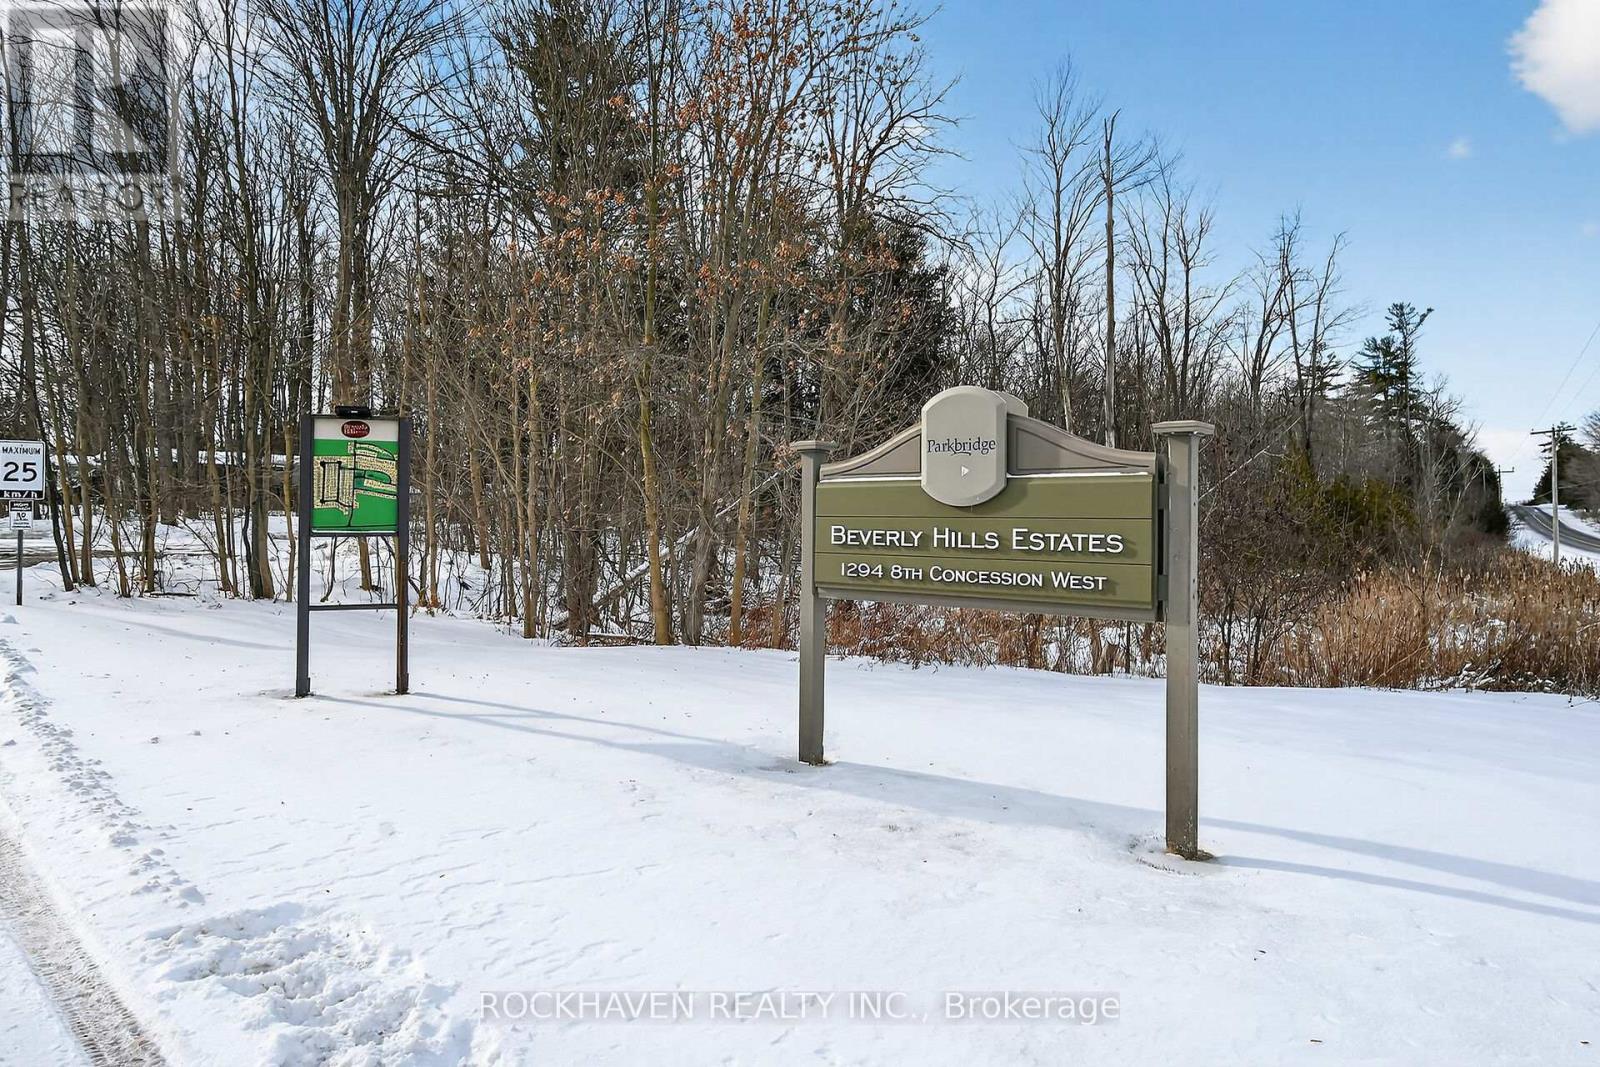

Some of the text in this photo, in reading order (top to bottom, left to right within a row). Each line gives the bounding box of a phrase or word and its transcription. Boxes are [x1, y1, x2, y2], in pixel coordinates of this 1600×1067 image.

[2, 446, 41, 455] MAXIMUM
[927, 437, 996, 456] Parkbridge
[3, 461, 38, 482] 25
[3, 490, 38, 498] km/h
[831, 525, 1124, 553] BEVERLY HILLS ESTATES
[841, 562, 1107, 590] 1294 8TH CONCESSION WEST
